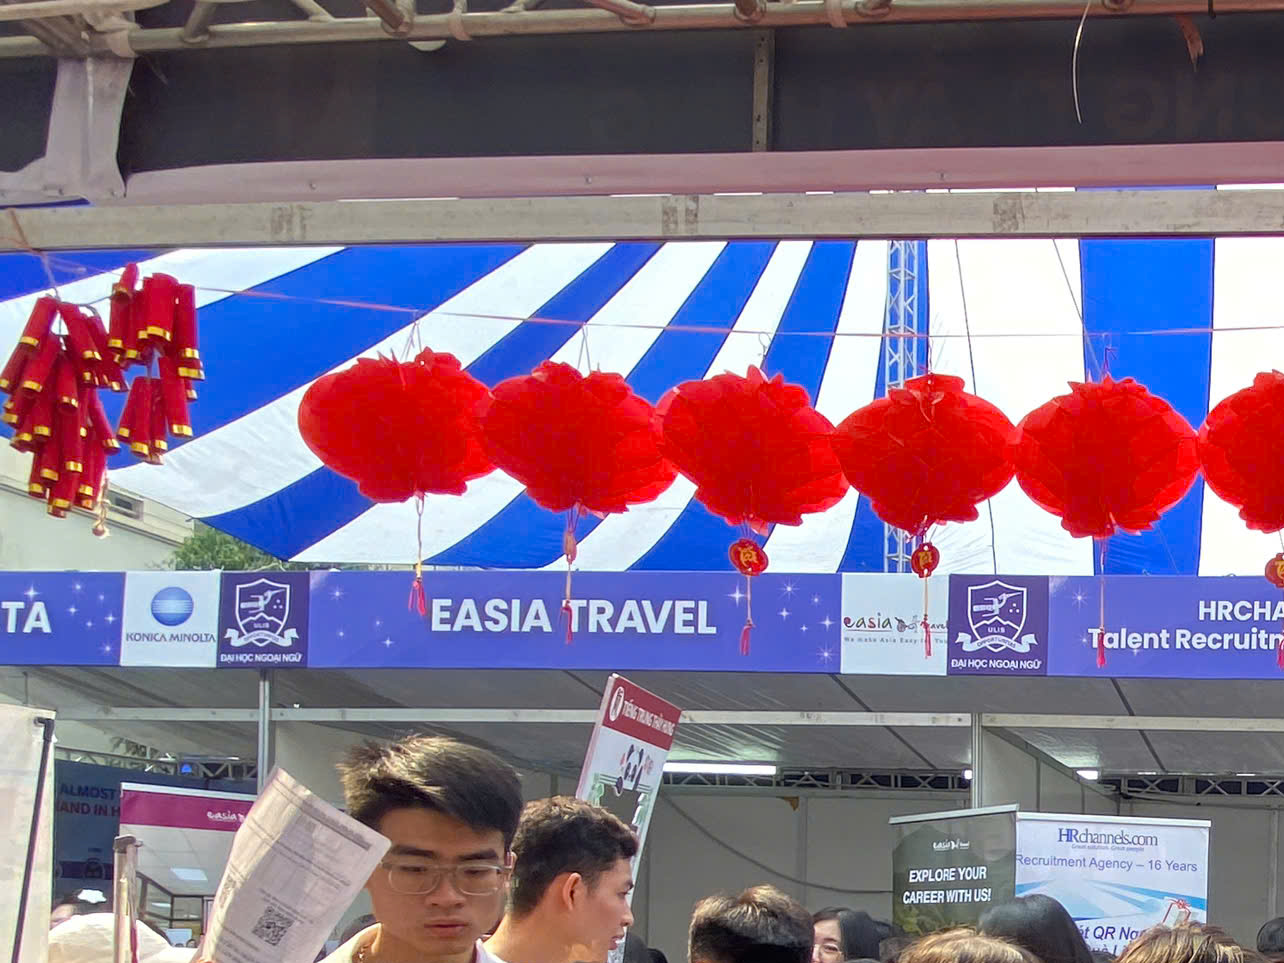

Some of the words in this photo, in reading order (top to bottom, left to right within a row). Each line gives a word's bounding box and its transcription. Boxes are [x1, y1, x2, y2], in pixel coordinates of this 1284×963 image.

[431, 598, 552, 632] EASIA
[563, 599, 717, 634] TRAVEL
[843, 612, 893, 629] easia
[126, 632, 167, 642] KONICA
[169, 633, 216, 643] MINOLTA
[1088, 628, 1170, 650] Talent
[255, 654, 281, 664] NGOẠI
[951, 658, 967, 670] ĐẠI
[968, 659, 987, 670] HỌC
[989, 659, 1018, 671] NGOẠI
[1020, 659, 1042, 669] NGỮ
[60, 783, 115, 799] ALMOST
[94, 804, 110, 816] IN
[206, 810, 238, 822] easia
[1057, 827, 1158, 847] HRchannels.com
[1016, 854, 1086, 868] Recruitment
[1090, 856, 1133, 872] Agency
[1148, 859, 1162, 871] 16
[1165, 859, 1198, 872] Years
[909, 868, 956, 883] EXPLORE
[958, 866, 987, 881] YOUR
[903, 890, 944, 904] CAREER
[945, 889, 972, 903] WITH
[973, 888, 991, 902] US!
[1093, 926, 1116, 940] QR
